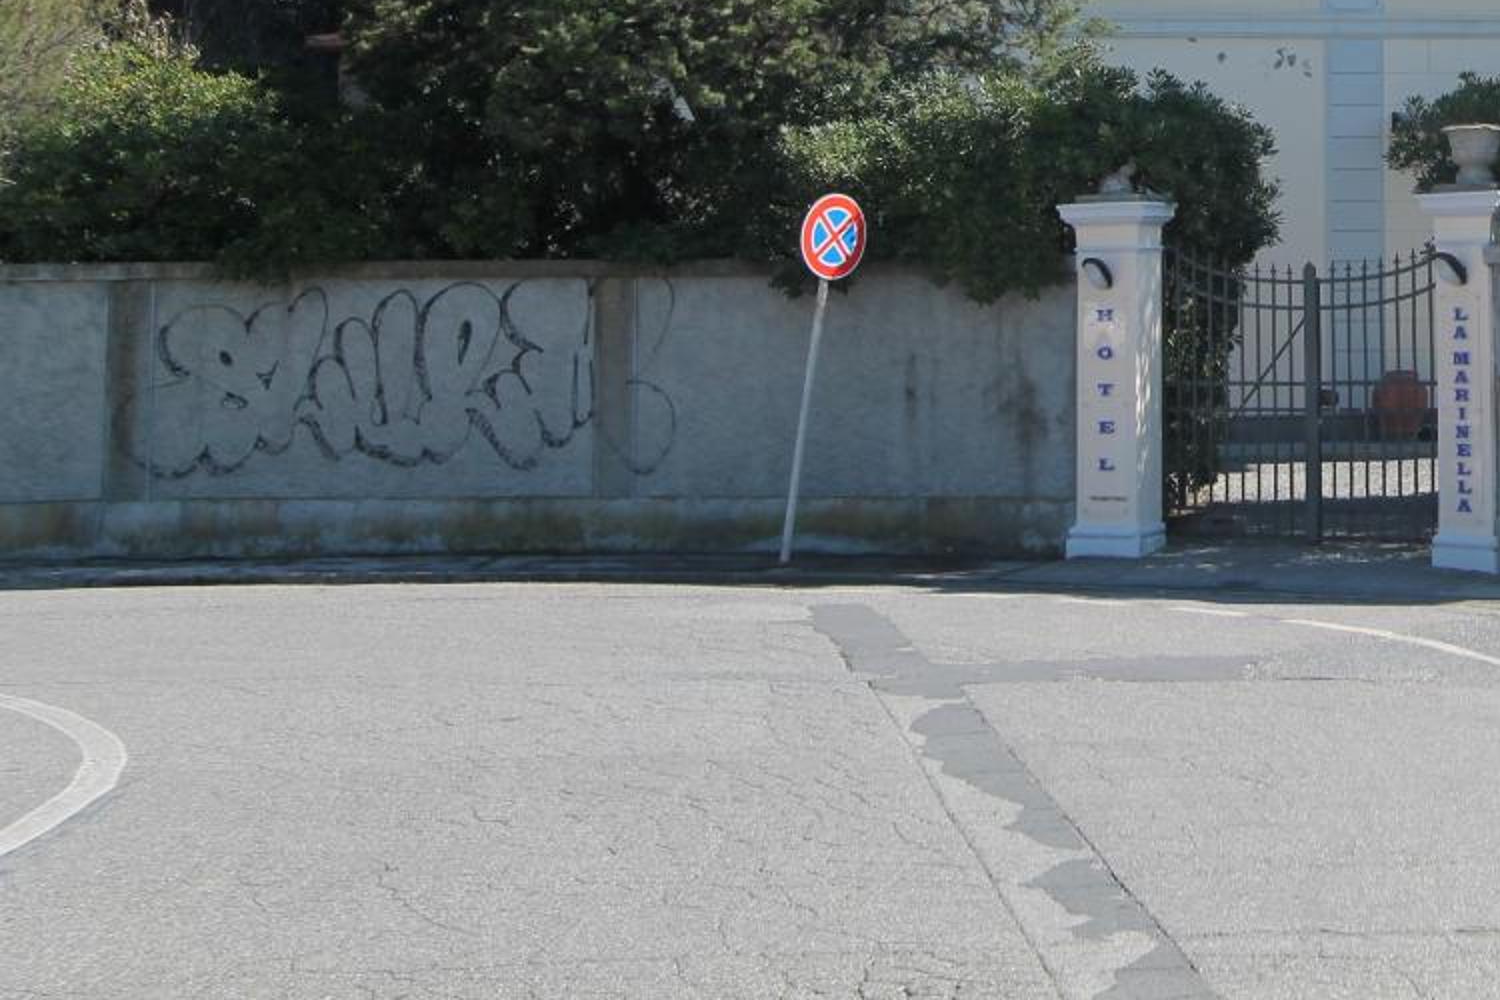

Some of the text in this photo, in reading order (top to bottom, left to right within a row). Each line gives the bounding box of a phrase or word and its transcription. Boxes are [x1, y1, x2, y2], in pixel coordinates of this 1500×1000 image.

[1097, 309, 1116, 472] HOTEL
[1453, 307, 1473, 513] LA MARINELLA
